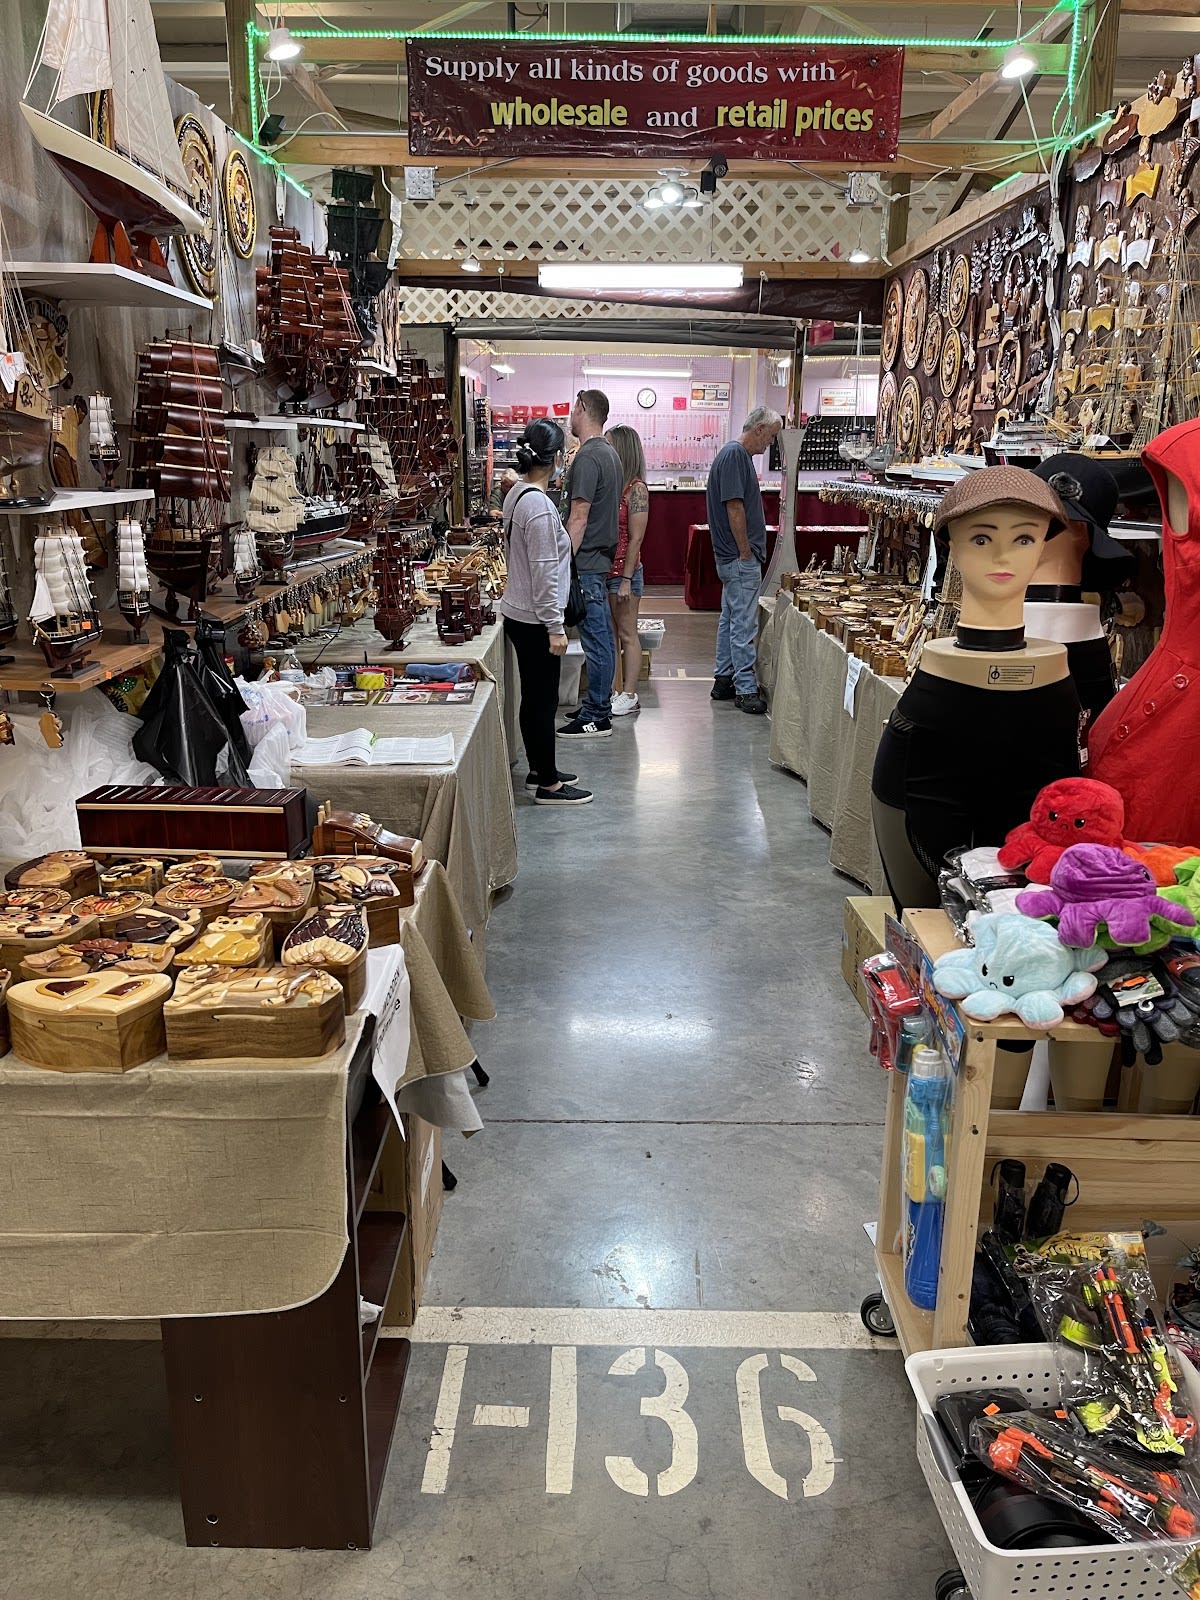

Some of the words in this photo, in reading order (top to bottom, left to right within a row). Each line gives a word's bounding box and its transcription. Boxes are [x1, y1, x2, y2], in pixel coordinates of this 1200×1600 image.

[425, 56, 520, 83] Supply
[529, 58, 561, 80] all
[570, 58, 644, 82] kinds
[652, 60, 680, 82] of
[686, 61, 768, 88] goods
[776, 61, 836, 83] with
[490, 96, 628, 126] wholesale
[646, 106, 698, 128] and
[717, 98, 788, 129] retail
[795, 99, 874, 137] prices
